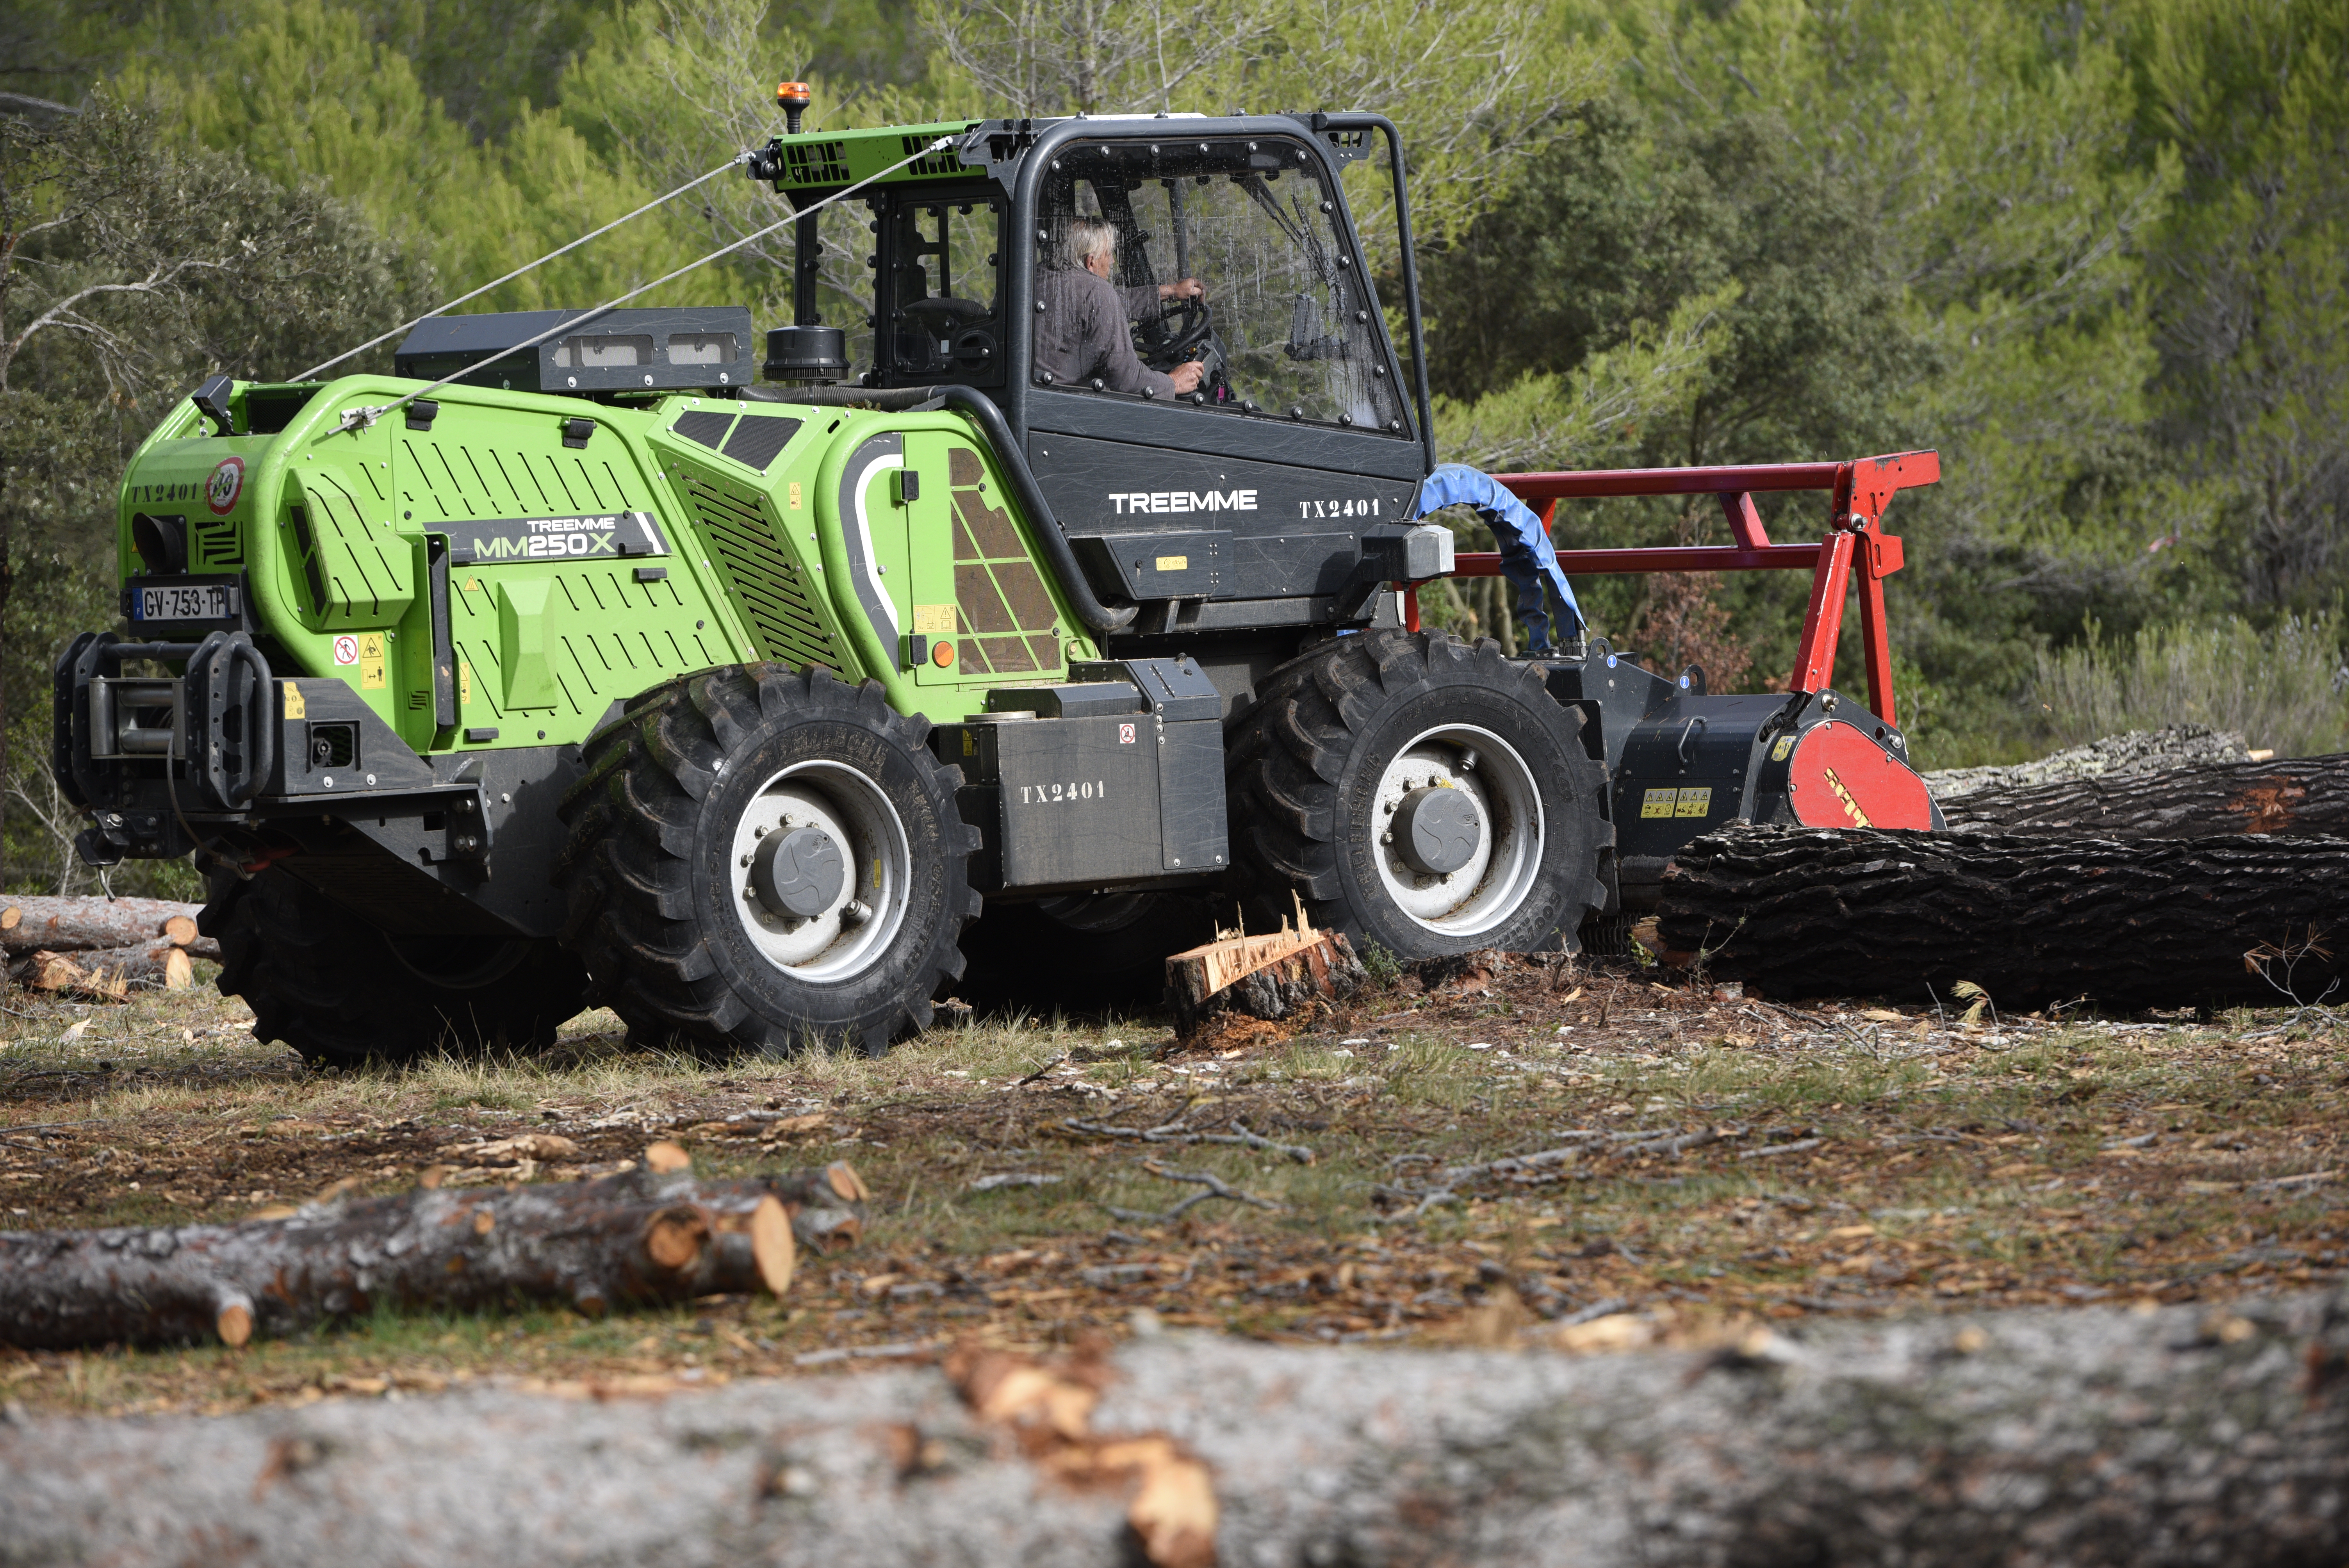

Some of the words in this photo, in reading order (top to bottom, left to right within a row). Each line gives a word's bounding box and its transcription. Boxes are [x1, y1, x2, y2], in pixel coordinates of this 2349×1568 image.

[132, 482, 197, 503] TX2401
[1109, 490, 1258, 514] TREEMME
[1299, 499, 1379, 519] TX2401
[527, 517, 616, 533] TREEMME
[474, 533, 616, 558] MM250X
[144, 589, 225, 617] GV-753-TP
[1445, 691, 1549, 743] FORESTRY
[1020, 780, 1105, 804] TX2401
[1349, 752, 1381, 903] TRELLEBORG
